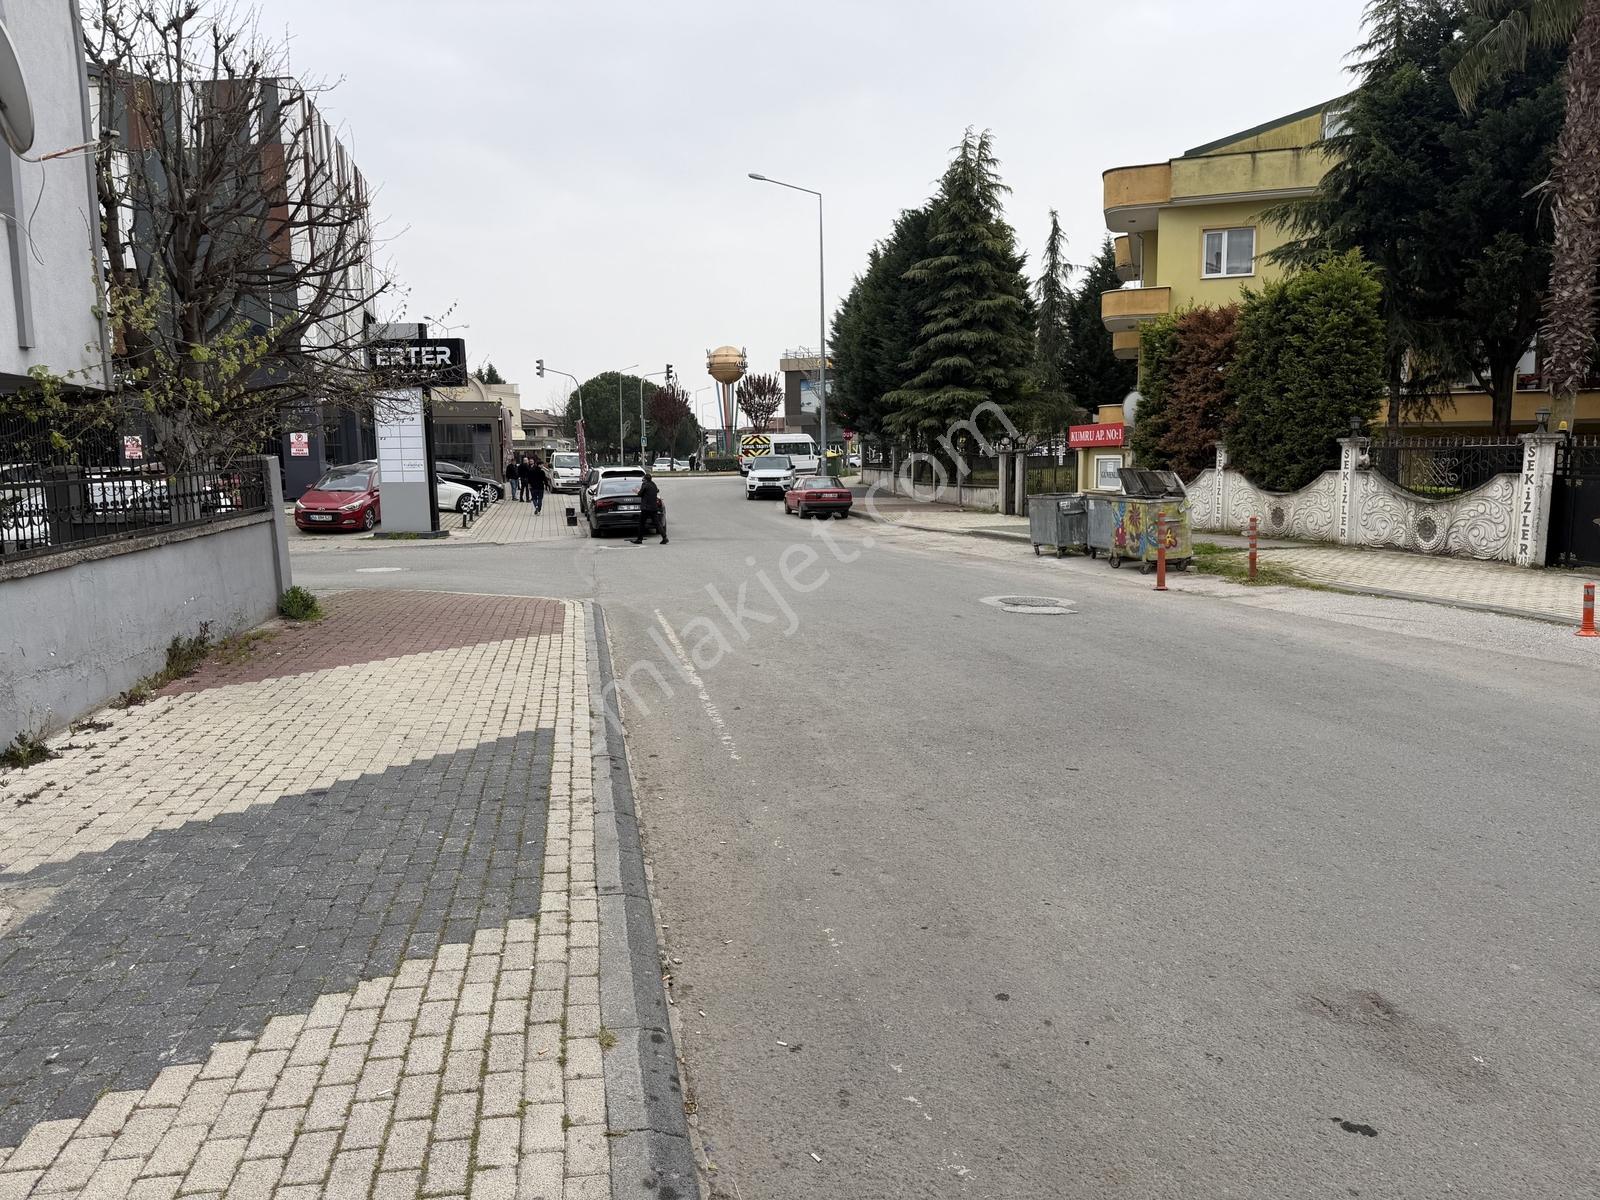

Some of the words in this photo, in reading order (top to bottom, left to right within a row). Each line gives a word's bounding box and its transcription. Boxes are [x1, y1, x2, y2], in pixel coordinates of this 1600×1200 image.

[376, 346, 452, 366] ERTER
[1070, 431, 1095, 441] KUMRU
[1096, 430, 1105, 440] AP.
